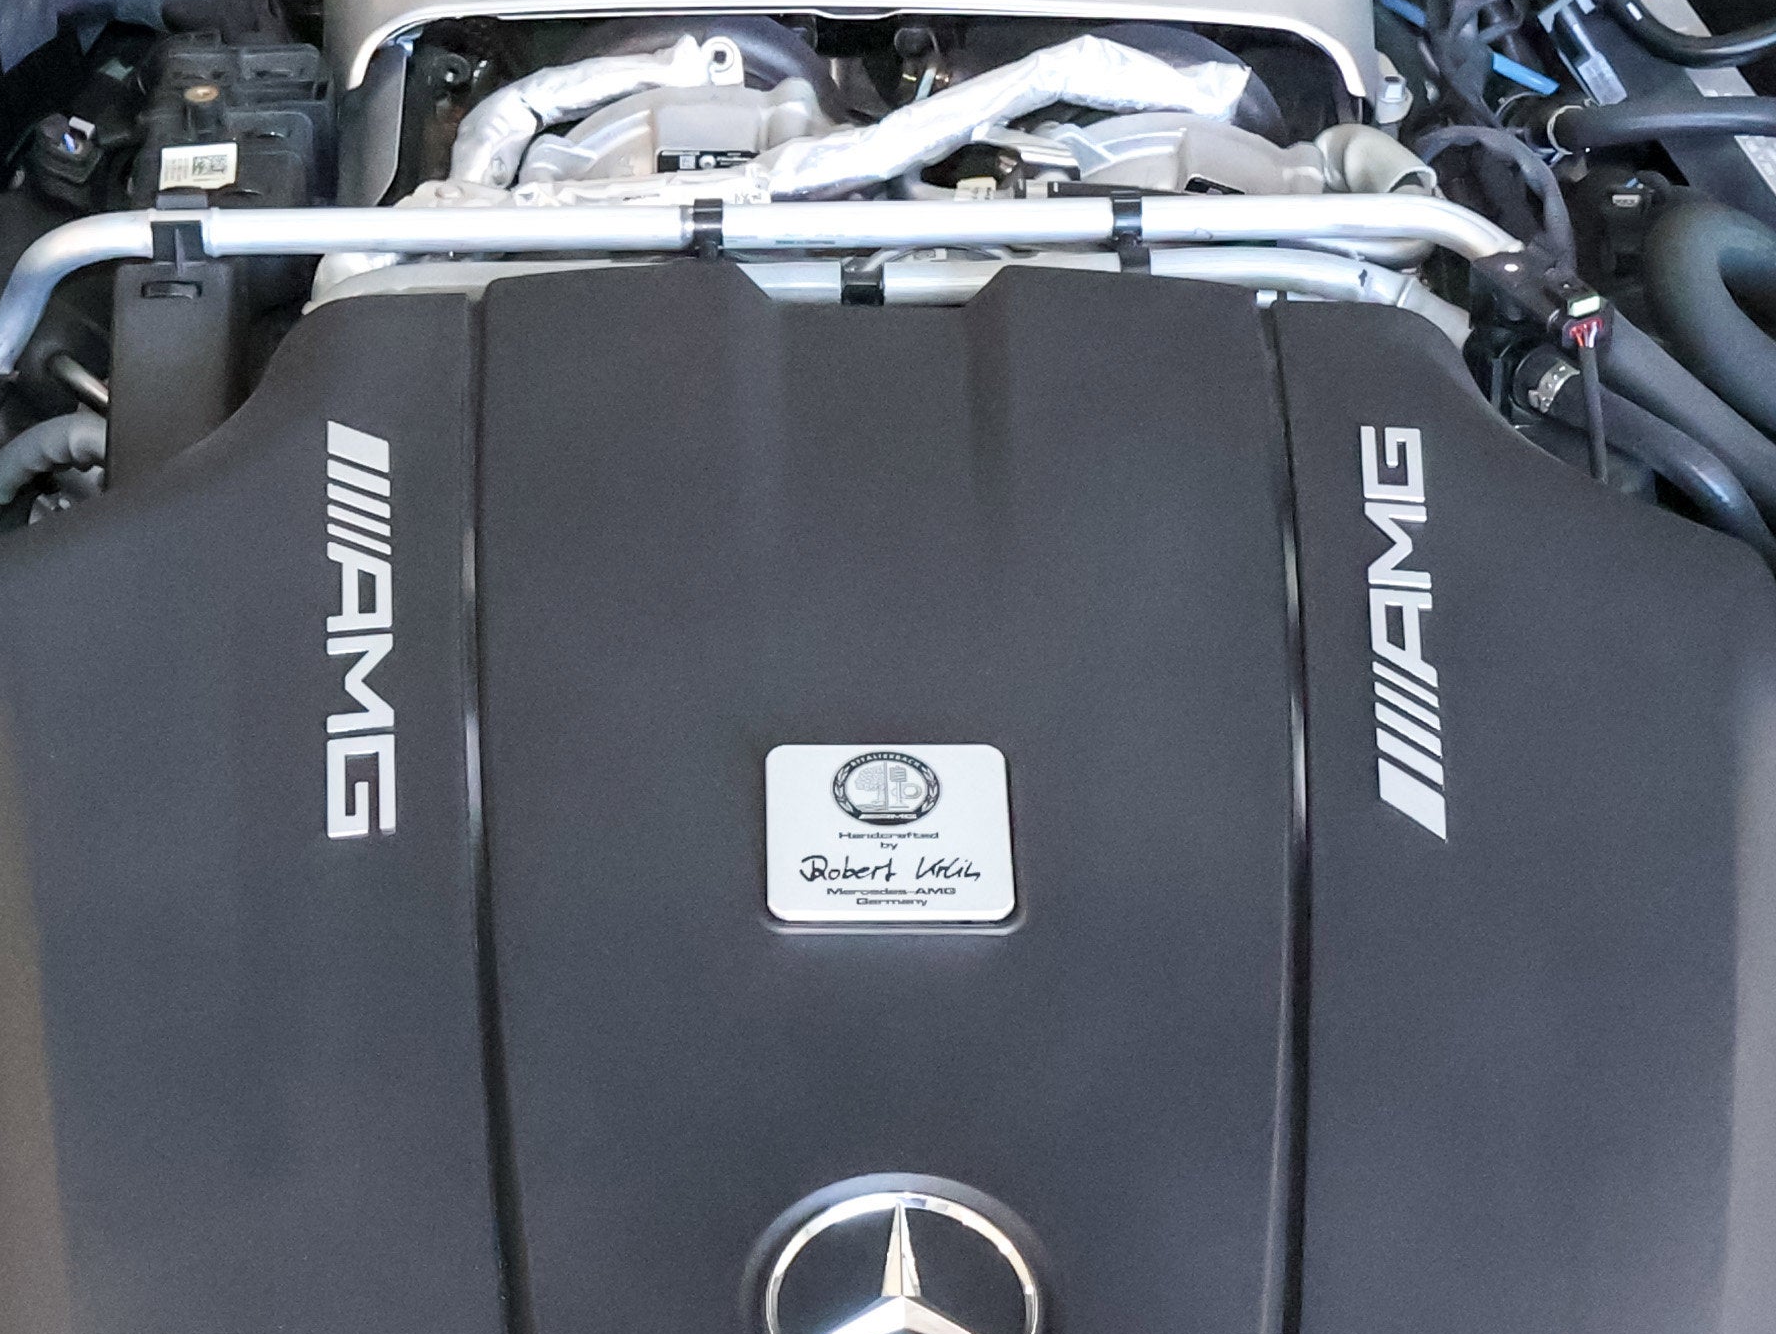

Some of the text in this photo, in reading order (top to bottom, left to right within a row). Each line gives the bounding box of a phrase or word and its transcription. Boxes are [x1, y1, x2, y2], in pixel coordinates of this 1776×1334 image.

[1360, 425, 1438, 689] AMG
[326, 541, 396, 839] AMG
[838, 831, 939, 839] Handcrafted
[880, 841, 898, 851] by
[799, 854, 897, 882] Robert
[826, 887, 957, 896] Mercedes-AMG
[856, 897, 928, 907] Germany
